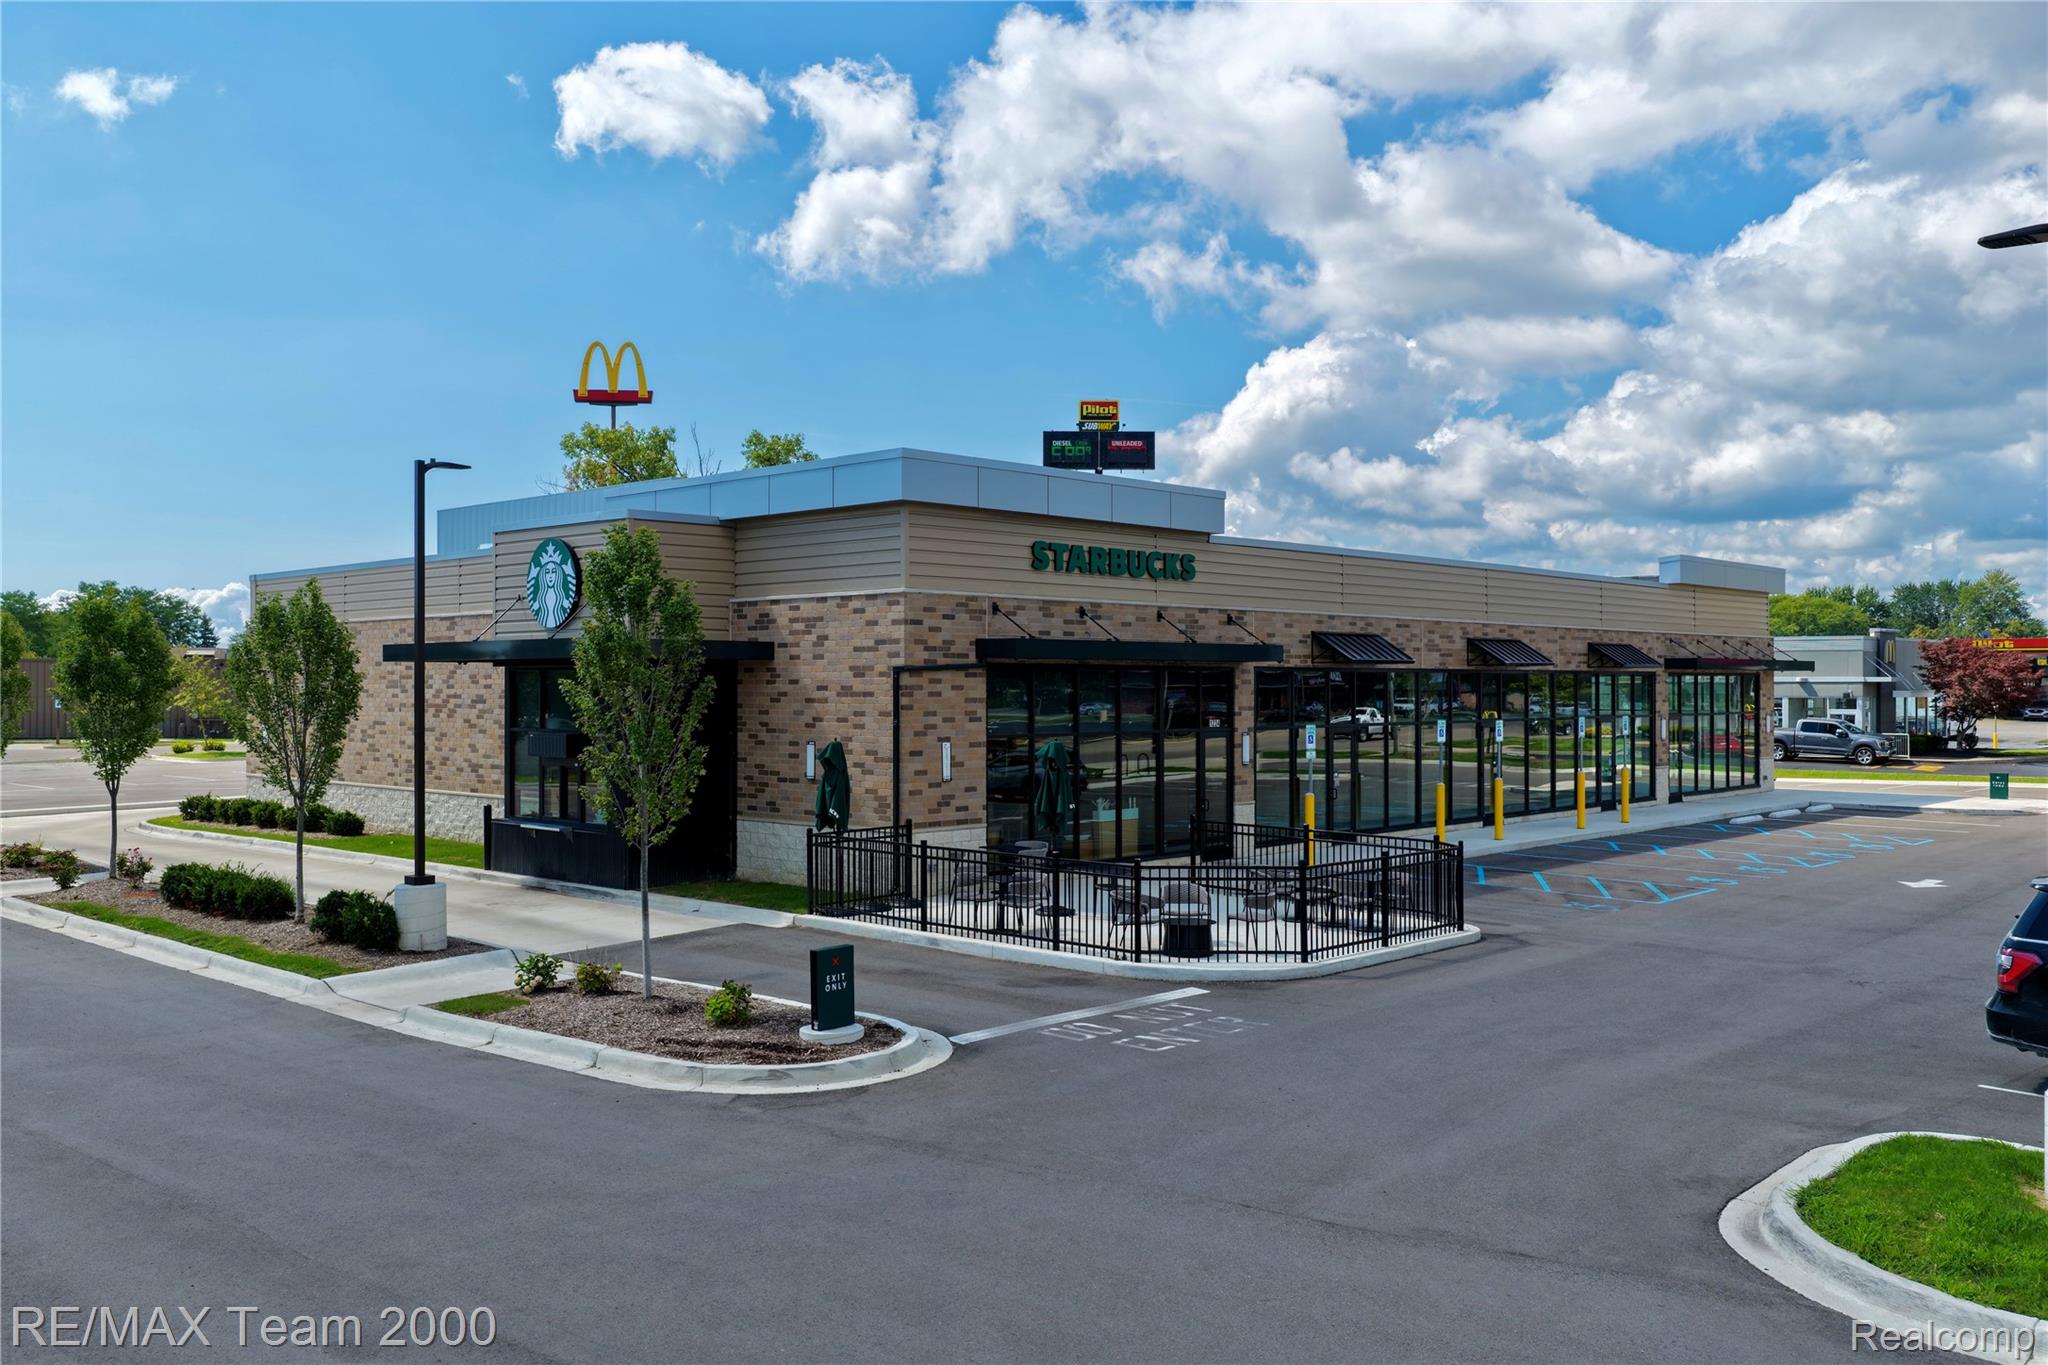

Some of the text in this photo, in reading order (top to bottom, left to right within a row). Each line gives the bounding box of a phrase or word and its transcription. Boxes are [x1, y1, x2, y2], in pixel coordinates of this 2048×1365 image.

[1082, 404, 1117, 416] Pilot
[1082, 422, 1117, 431] SUBWAY
[1031, 540, 1197, 581] STARBUCKS
[826, 972, 846, 983] EXIT
[824, 981, 848, 992] ONLY
